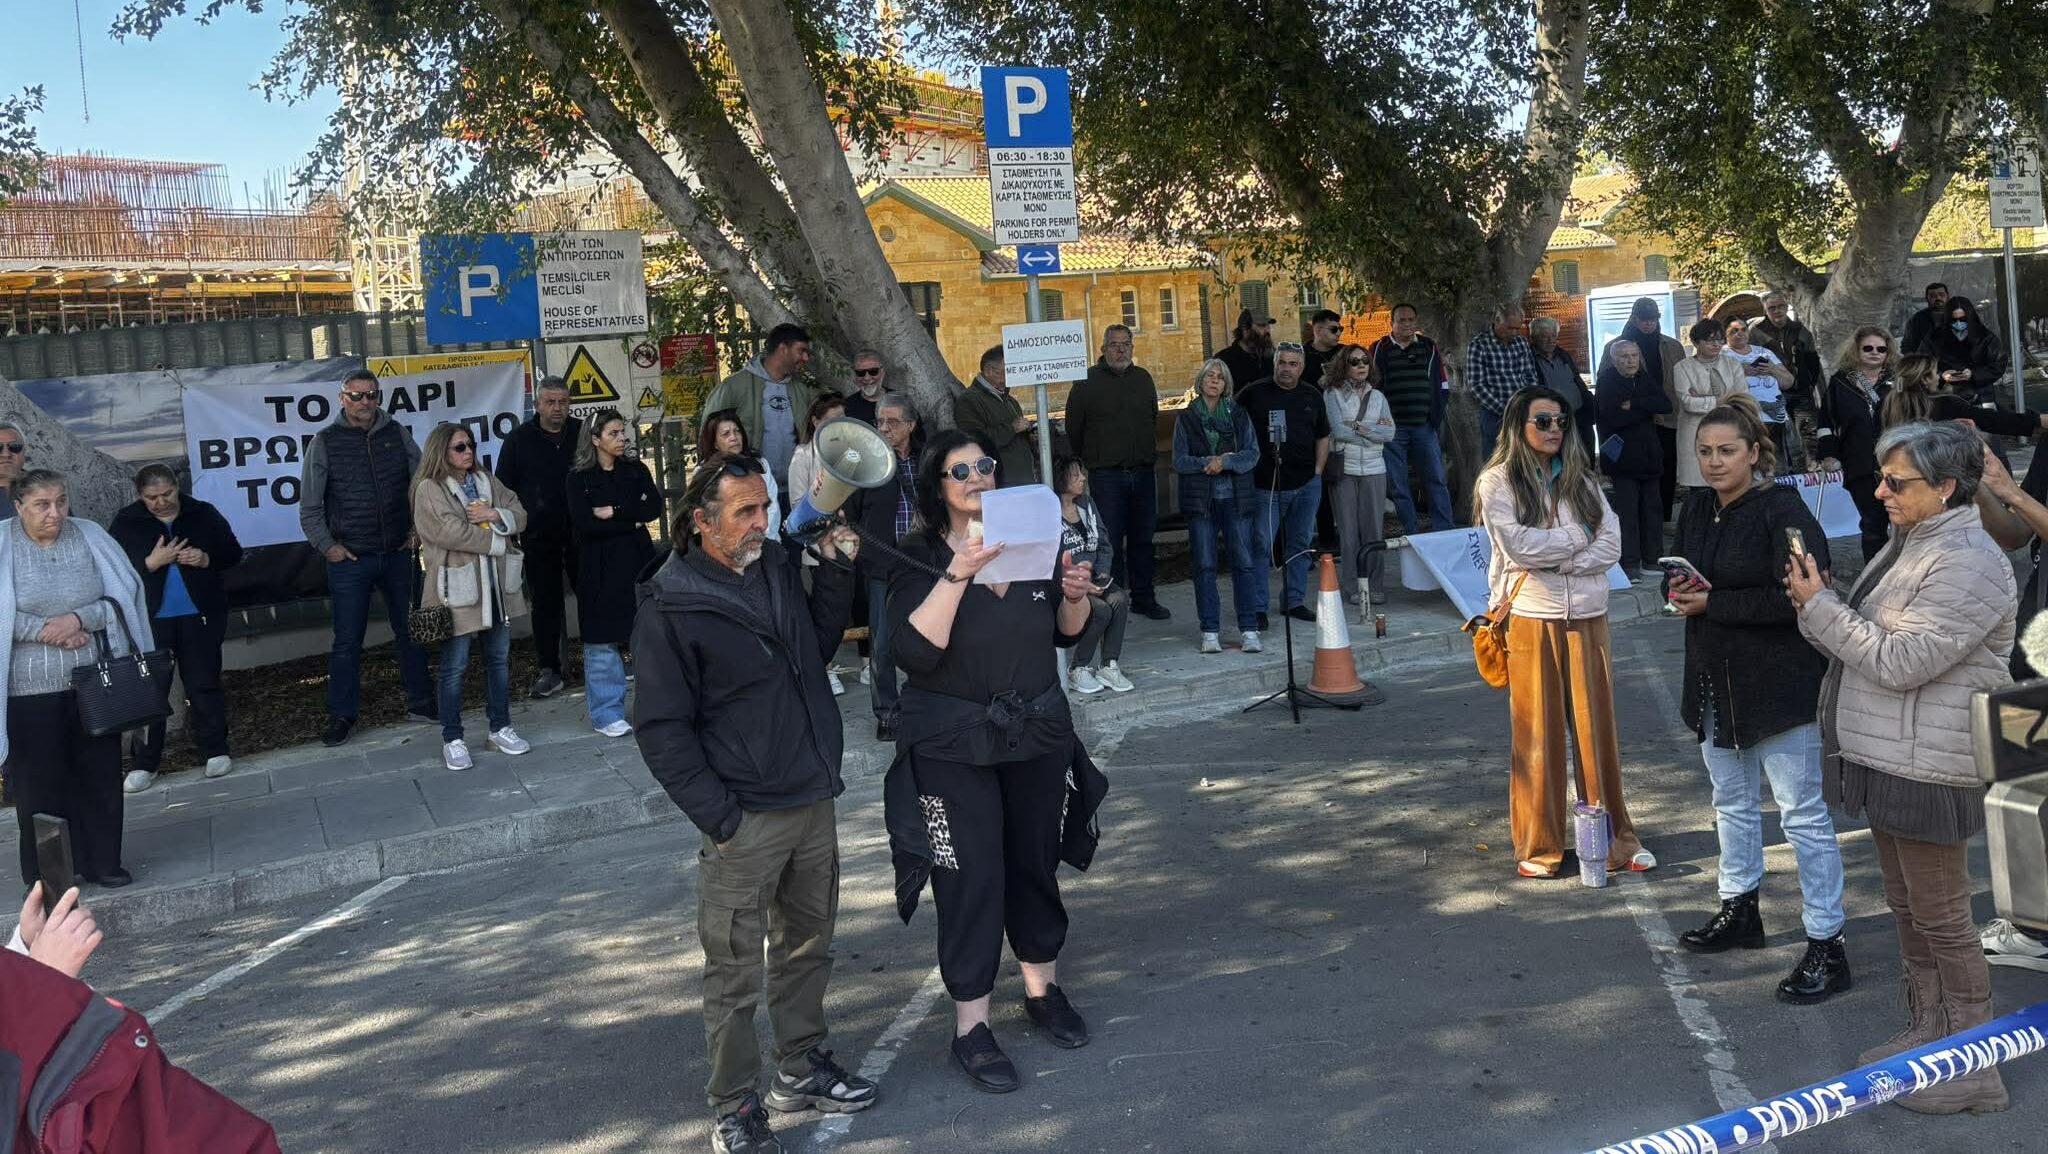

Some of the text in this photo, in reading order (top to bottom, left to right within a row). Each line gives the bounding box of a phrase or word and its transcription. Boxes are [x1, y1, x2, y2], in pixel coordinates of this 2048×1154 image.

[1005, 76, 1047, 137] P
[997, 151, 1026, 161] 06:30
[1037, 151, 1065, 161] 18:30
[1003, 168, 1062, 178] ΣΤΑΘΜΕΥΣΗ ΓΙΑ
[1001, 179, 1065, 190] ΔΙΚΑΙΟΥΧΟΥΣ ΜΕ
[996, 190, 1073, 202] ΚΑΡΤΑ ΣΤΑΘΜΕΥΣΗΣ
[1024, 203, 1047, 213] ΜΟΝΟ
[995, 216, 1076, 228] PARKING FOR PERMIT
[1008, 228, 1066, 239] HOLDERS ONLY
[582, 238, 604, 248] ΤΩΝ
[540, 250, 624, 262] ΑΝΤΙΠΡΟΣΩΠΩΝ
[458, 264, 500, 316] P
[544, 305, 598, 318] HOUSE OF
[545, 315, 645, 330] REPRESENTATIVES
[1007, 333, 1083, 349] ΔΗΜΟΣΙΟΓΡΑΦΟΙ
[1006, 360, 1086, 374] ΜΕ ΚΑΡΤΑ ΣΤΑΘΜΕΥΣΗΣ
[1036, 372, 1059, 381] ΜΟΝΟ
[264, 380, 456, 423] ΤΟ ΑΡΙ
[1747, 1081, 1856, 1144] POLICE
[1906, 1025, 2046, 1095] ΑΣΤΥΝΟΜΙΑ
